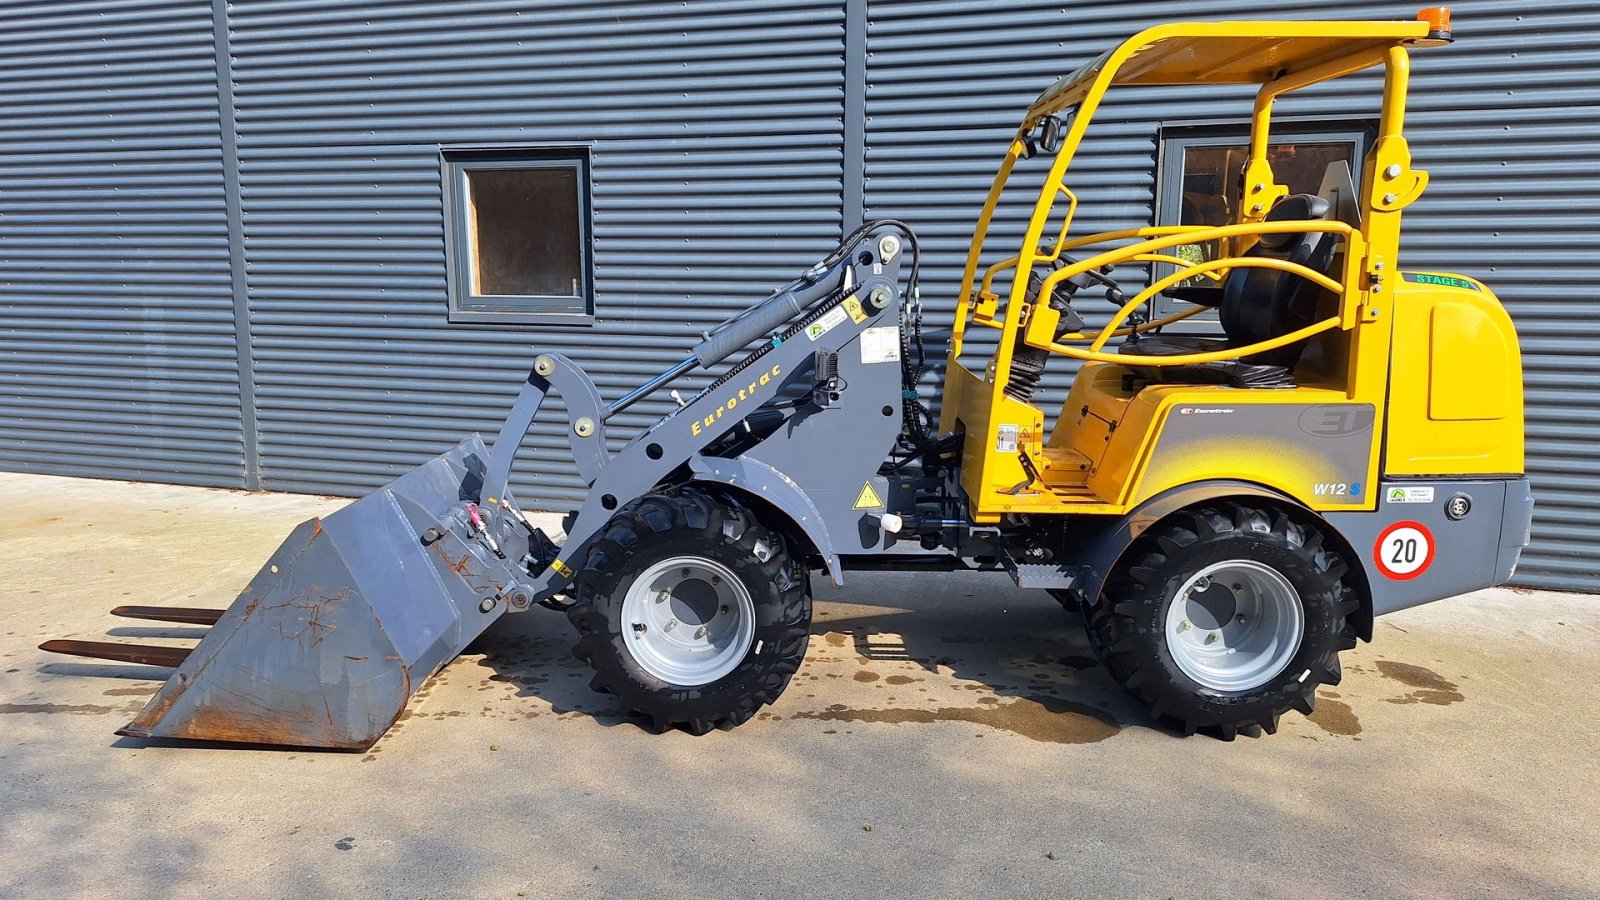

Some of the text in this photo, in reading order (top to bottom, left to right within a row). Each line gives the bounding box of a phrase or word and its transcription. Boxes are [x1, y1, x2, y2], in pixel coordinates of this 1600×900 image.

[1416, 274, 1469, 288] STAGE 5
[690, 364, 781, 437] Eurotrac
[1313, 481, 1361, 497] W12 S
[1391, 538, 1417, 564] 20
